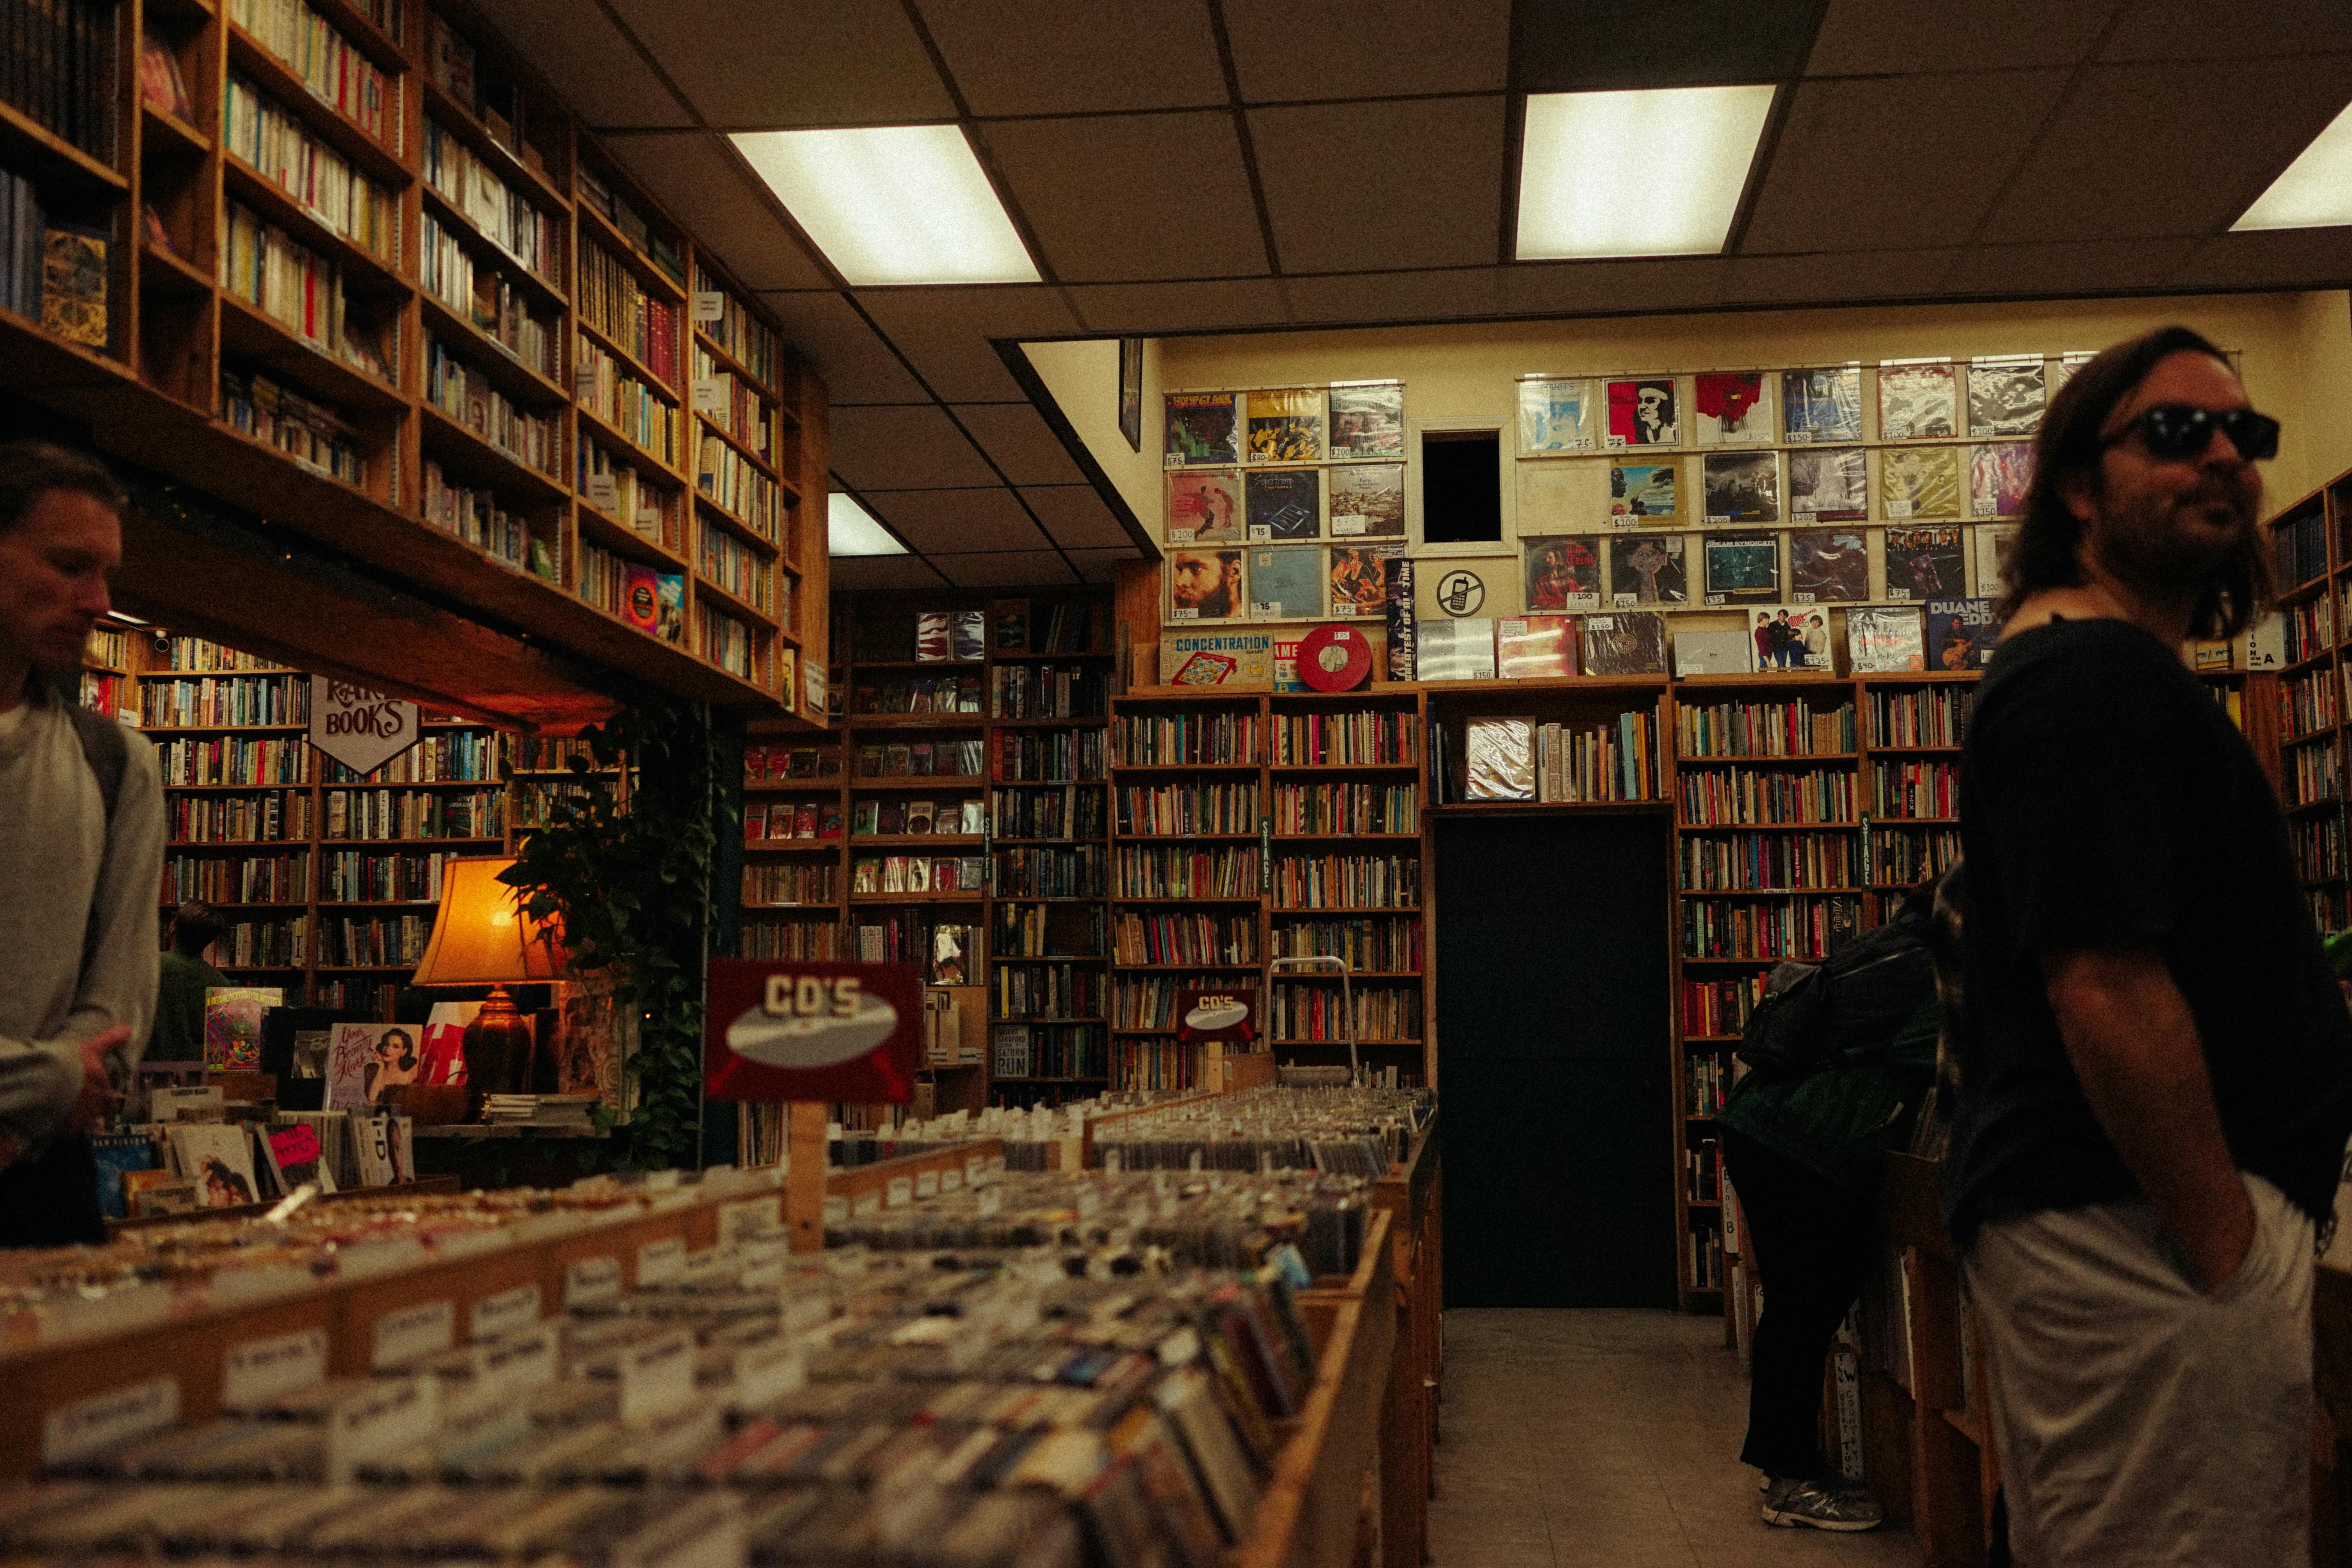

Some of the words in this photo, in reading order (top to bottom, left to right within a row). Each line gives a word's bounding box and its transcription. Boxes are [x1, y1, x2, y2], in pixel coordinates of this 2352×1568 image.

[1930, 601, 1989, 614] DUANE
[1176, 636, 1270, 652] CONCENTRATION
[1404, 632, 1414, 681] GREATEST
[2264, 653, 2274, 664] A
[326, 700, 402, 738] BOOKS
[765, 974, 862, 1017] CD'S
[1198, 995, 1234, 1010] CD'S
[998, 1048, 1025, 1057] SATURN
[998, 1058, 1025, 1075] RUN
